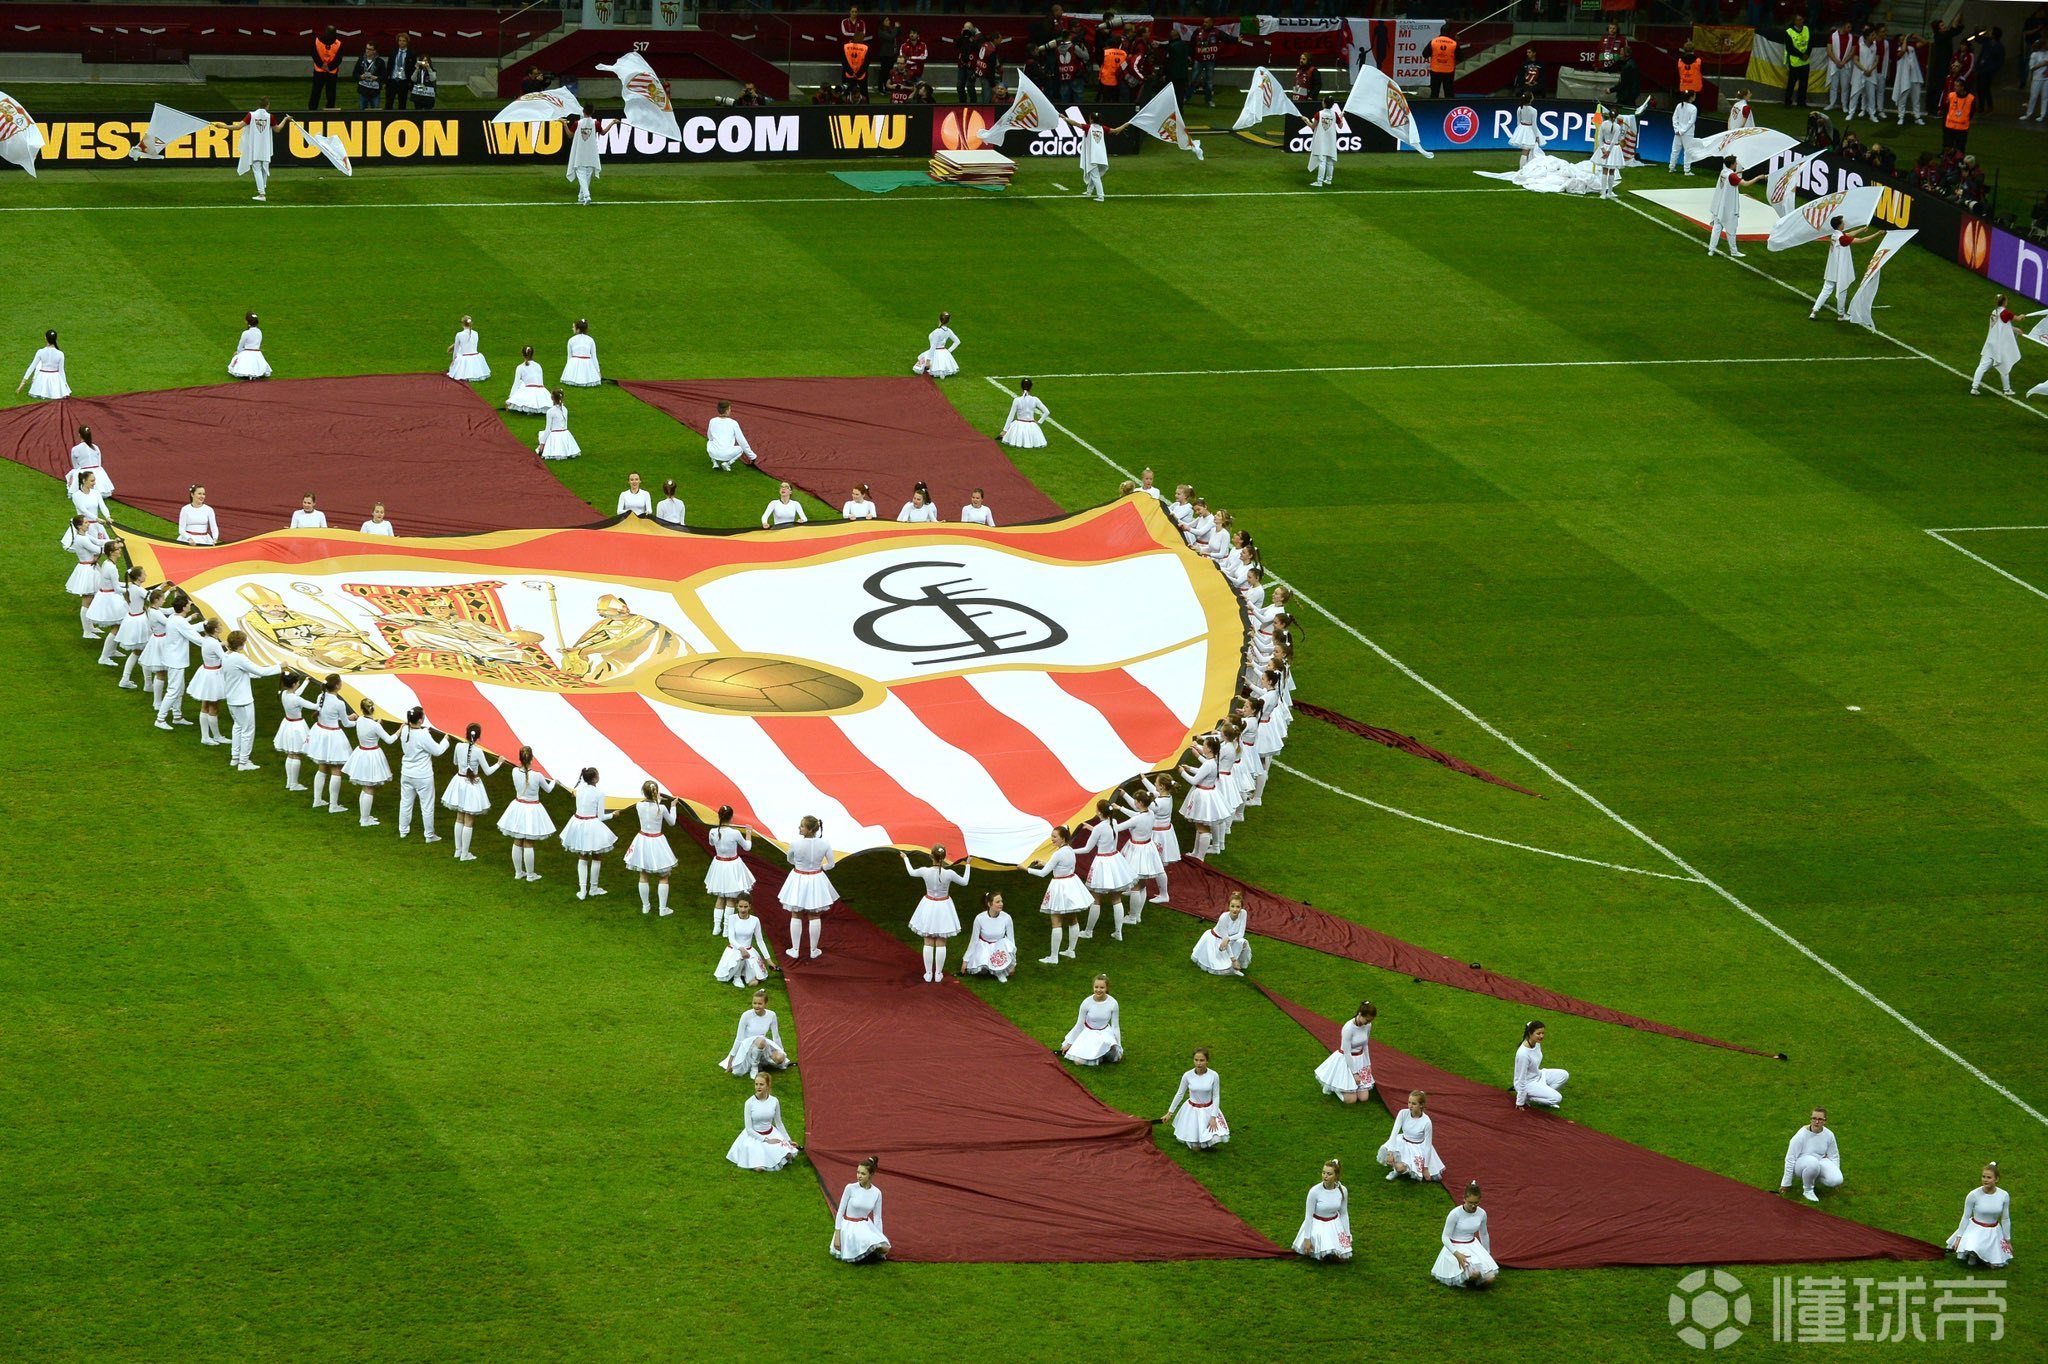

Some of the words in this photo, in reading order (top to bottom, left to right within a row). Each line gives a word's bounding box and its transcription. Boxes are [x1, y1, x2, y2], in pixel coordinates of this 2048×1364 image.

[1398, 29, 1411, 38] MI
[633, 41, 650, 52] S17
[1398, 42, 1416, 52] TIO
[1397, 56, 1431, 65] TENIA
[1580, 52, 1596, 62] S18
[1451, 107, 1473, 120] UEFA
[833, 114, 907, 150] WU
